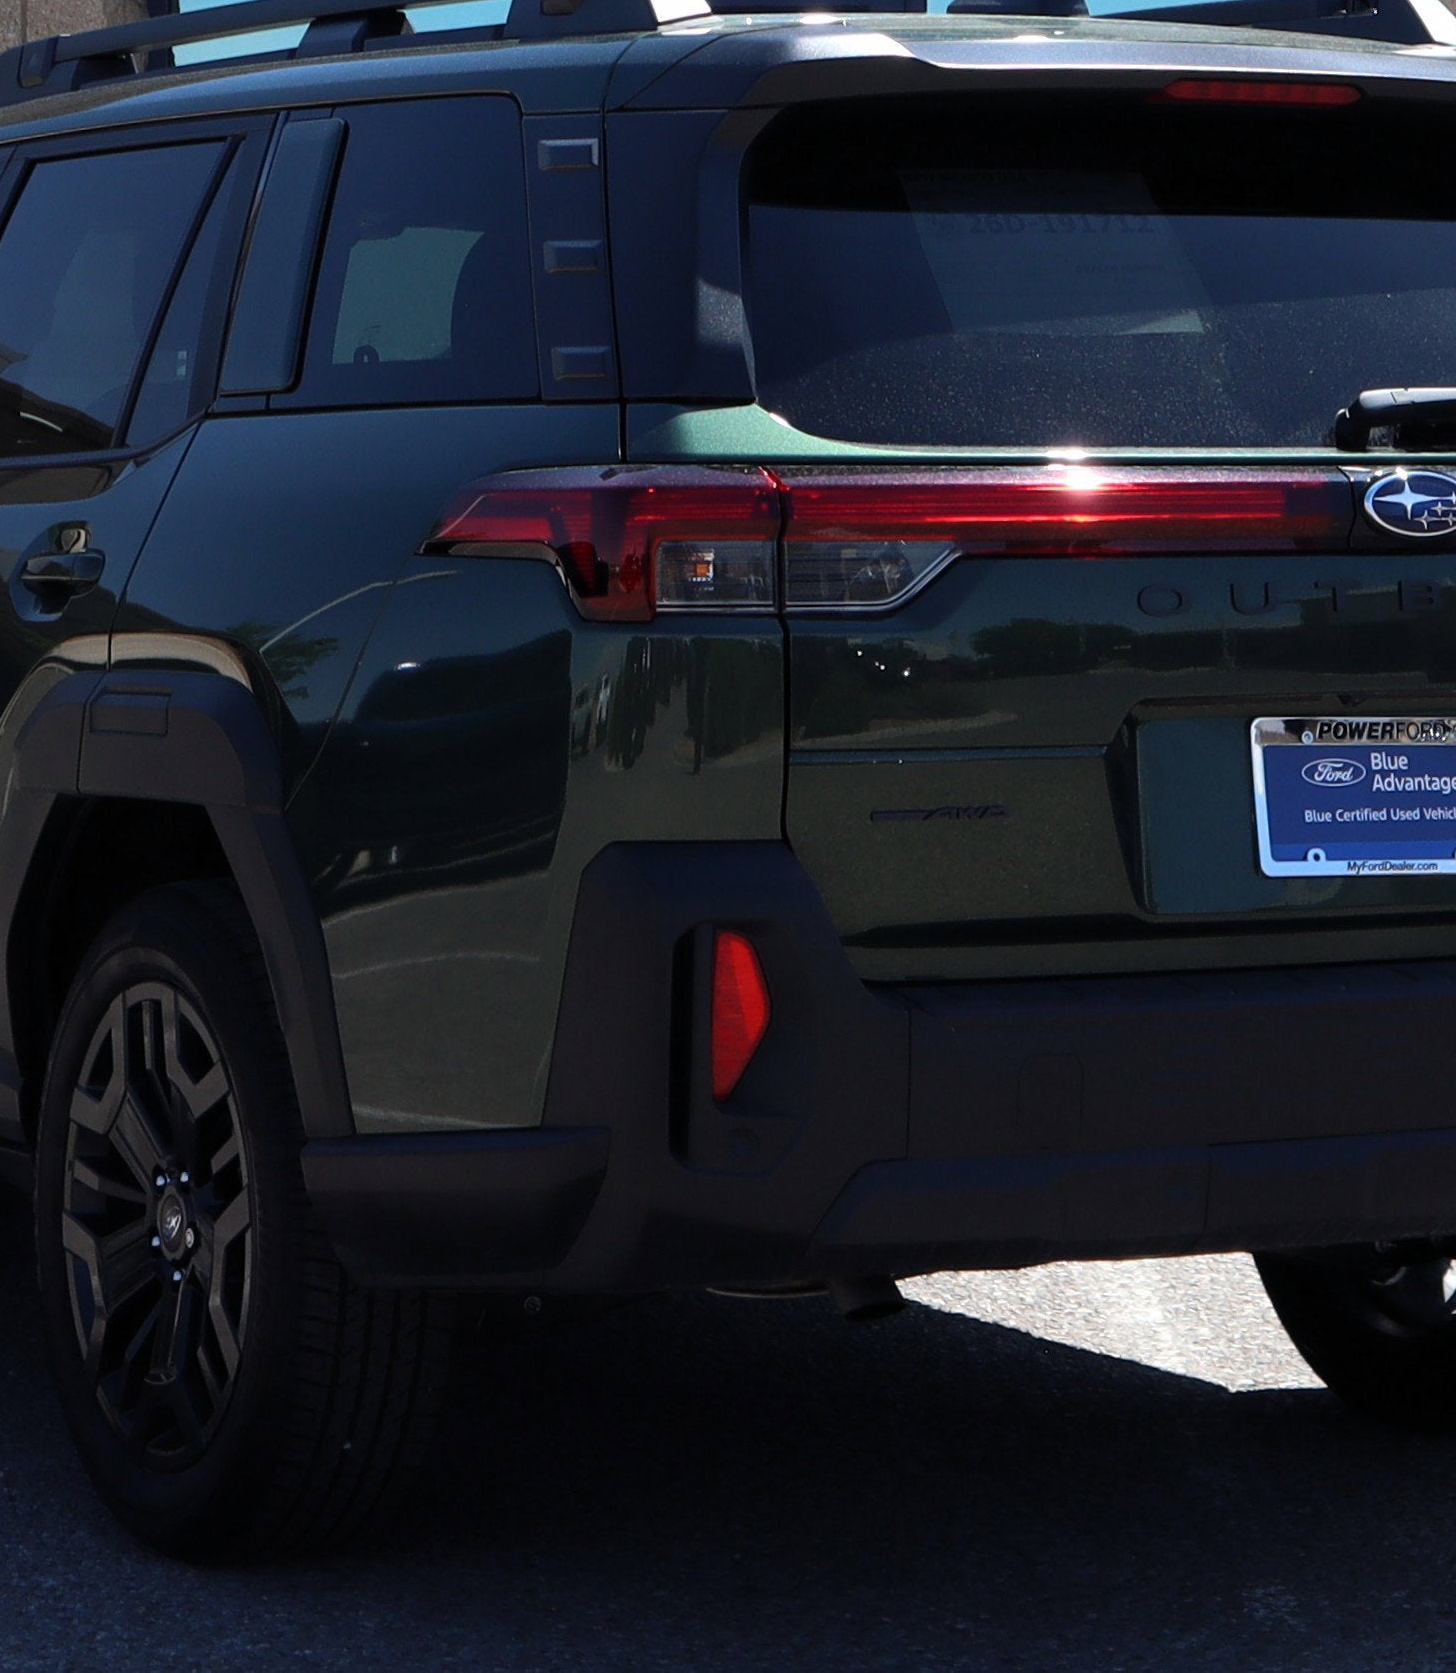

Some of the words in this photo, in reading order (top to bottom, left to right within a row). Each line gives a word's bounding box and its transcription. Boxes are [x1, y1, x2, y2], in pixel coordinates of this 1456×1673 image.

[1370, 752, 1409, 770] Blue
[1314, 762, 1354, 782] Ford
[1304, 809, 1332, 823] Blue
[1335, 807, 1387, 822] Certified
[1390, 807, 1420, 821] Used
[1347, 861, 1438, 874] MyFordDealer.com
